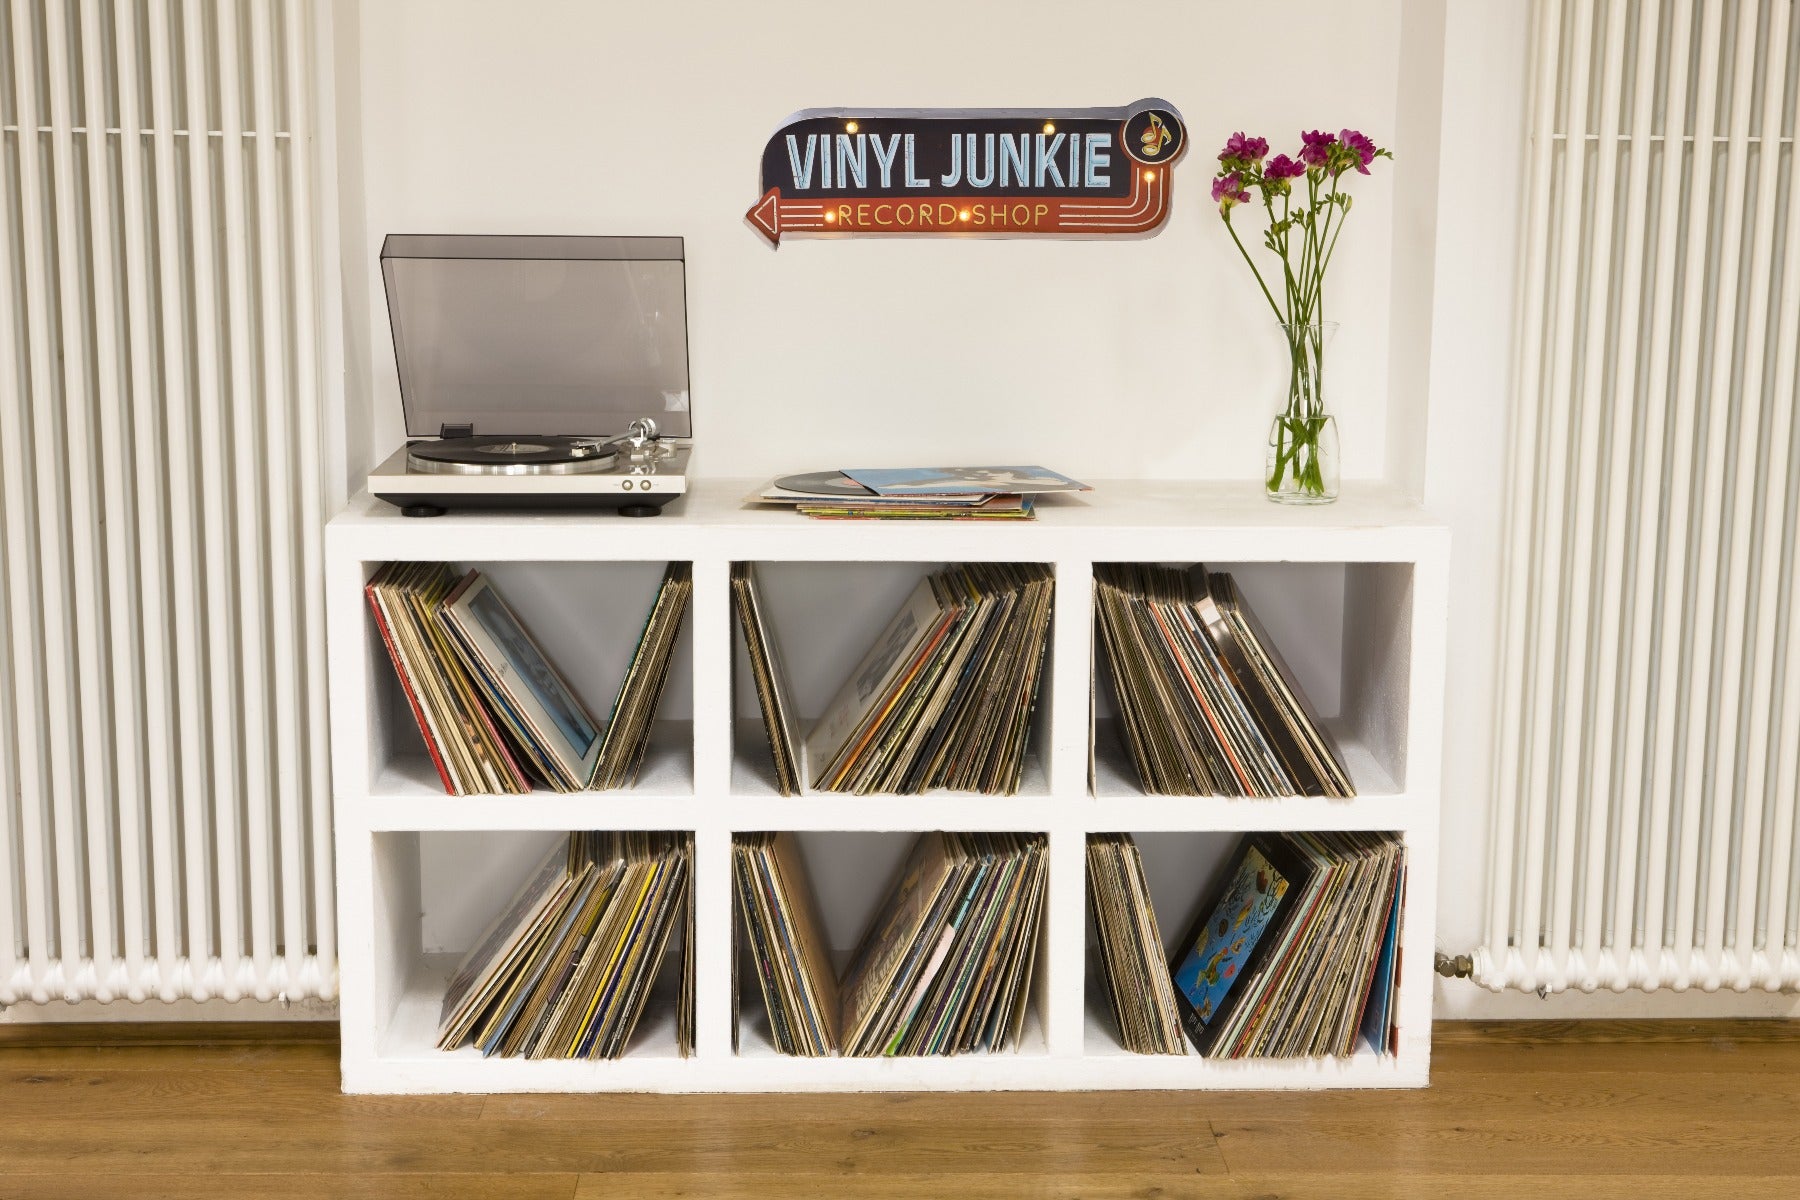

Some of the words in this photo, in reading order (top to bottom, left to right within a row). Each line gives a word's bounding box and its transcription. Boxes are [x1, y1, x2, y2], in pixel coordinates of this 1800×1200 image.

[785, 133, 931, 190] VINYL
[941, 133, 1112, 188] JUNKIE
[838, 203, 957, 226] RECORD
[972, 204, 1049, 226] SHOP
